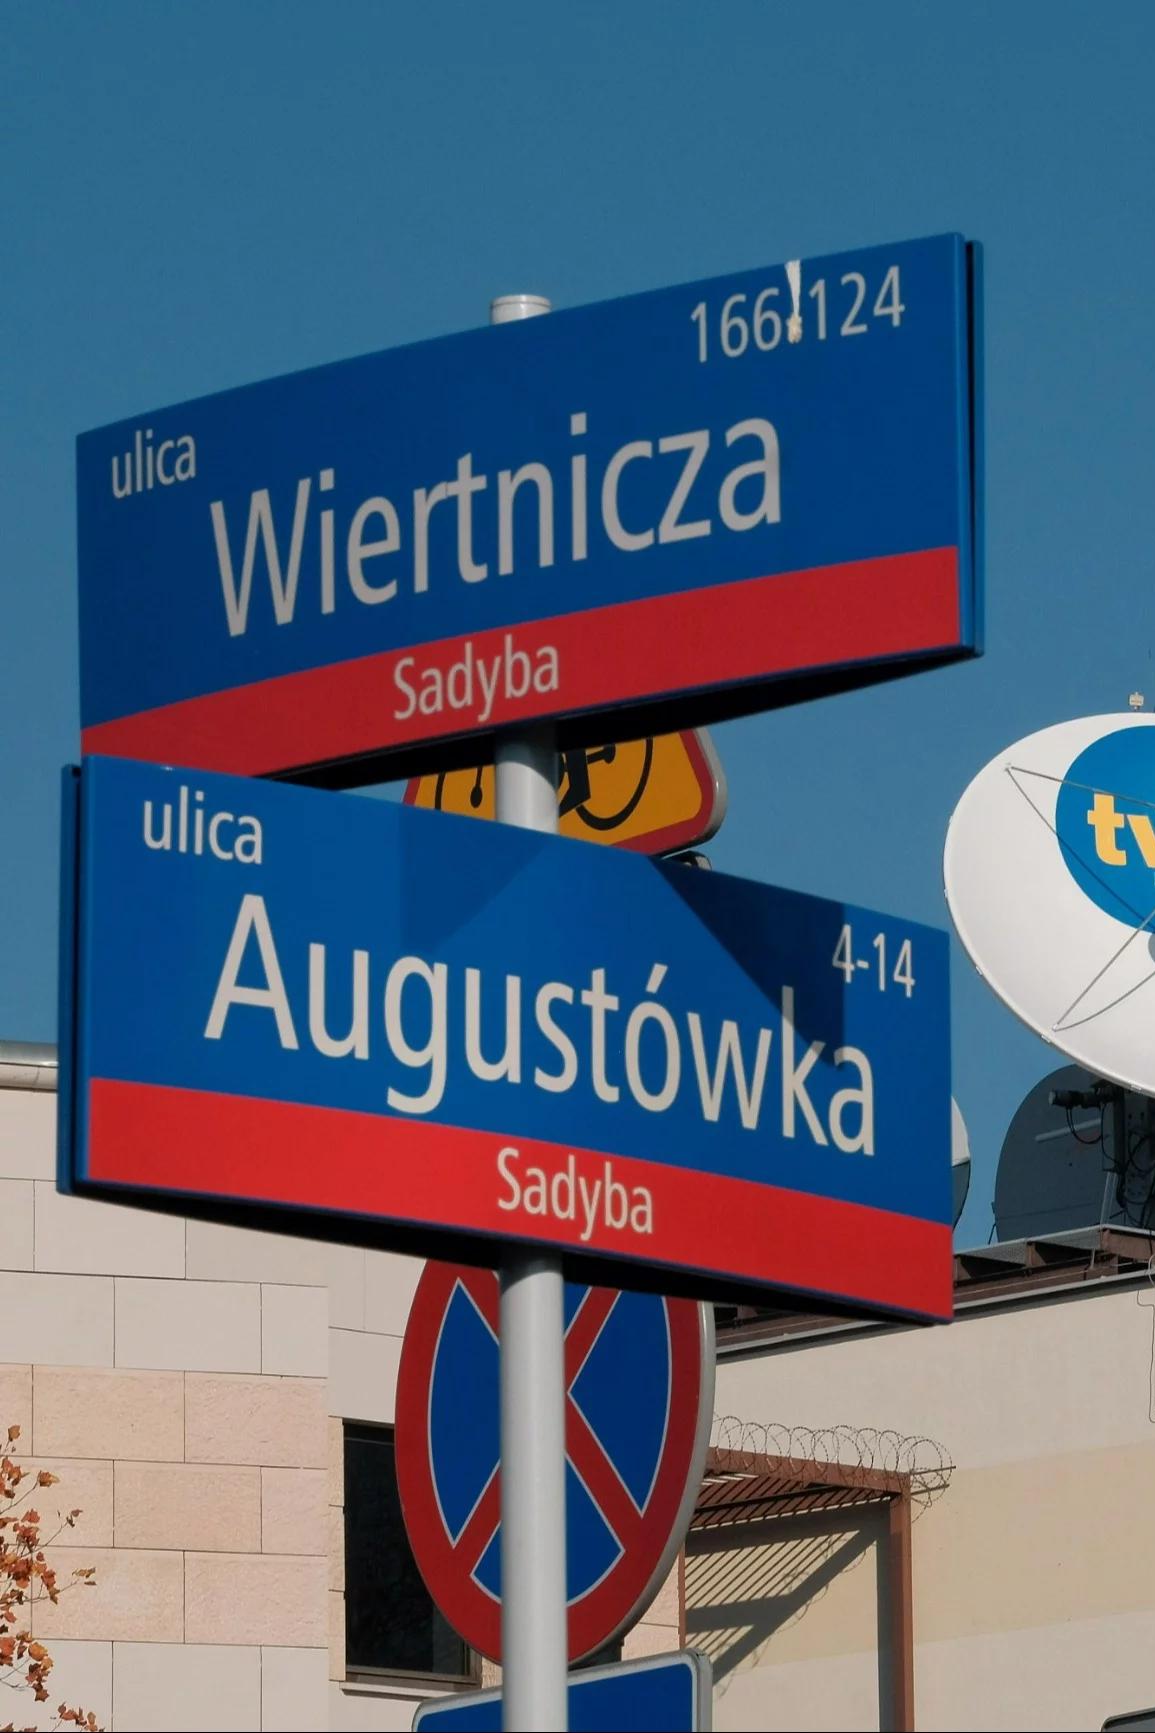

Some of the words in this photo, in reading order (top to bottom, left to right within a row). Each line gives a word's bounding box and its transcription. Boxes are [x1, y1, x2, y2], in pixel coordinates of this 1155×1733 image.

[691, 265, 906, 363] 166124
[111, 430, 197, 499] ulica
[210, 411, 782, 637] Wiertnicza
[392, 632, 560, 723] Sadyba
[142, 784, 264, 866] ulica
[832, 923, 917, 999] 4-14
[203, 892, 876, 1157] Augustówka
[495, 1145, 654, 1243] Sadyba
